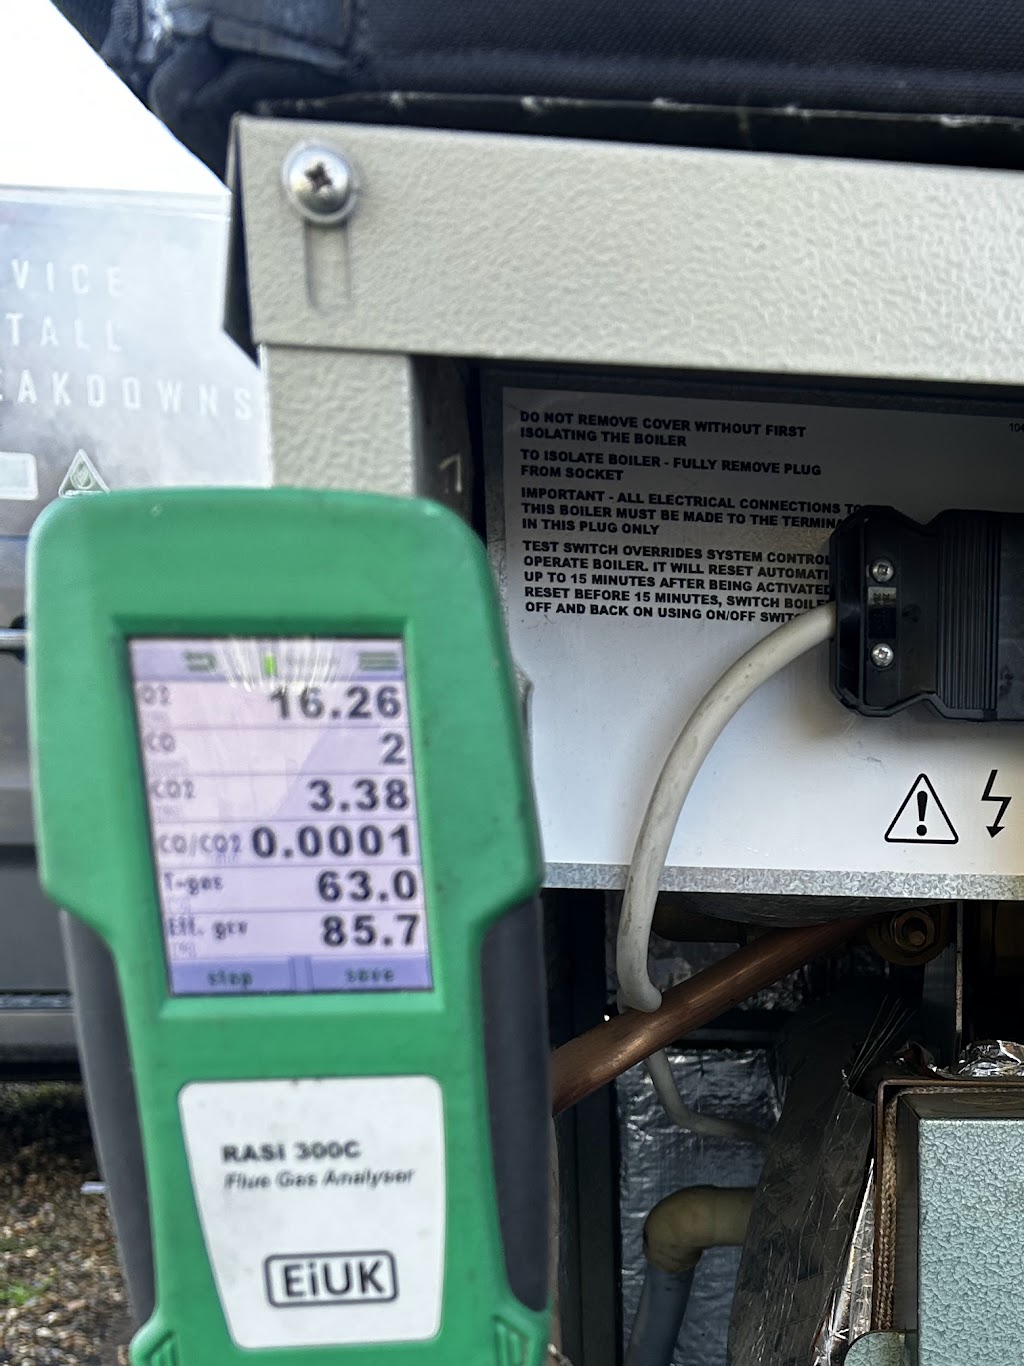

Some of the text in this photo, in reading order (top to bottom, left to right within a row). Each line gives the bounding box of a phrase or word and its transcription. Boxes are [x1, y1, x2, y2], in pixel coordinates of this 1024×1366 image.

[520, 411, 806, 437] DO NOT REMOVE COVER WITHOUT FIRST
[520, 427, 687, 447] ISOLATING THE BOILER
[520, 449, 539, 460] TO
[544, 450, 604, 464] ISOLATE
[608, 454, 661, 467] BOILER
[673, 457, 717, 470] FULLY
[721, 460, 780, 474] REMOVE
[784, 463, 822, 476] PLUG
[520, 465, 624, 480] FROM SOCKET
[521, 487, 605, 501] IMPORTANT
[617, 492, 644, 504] ALL
[648, 493, 735, 508] ELECTRICAL
[740, 498, 841, 514] CONNECTIONS
[521, 503, 555, 515] THIS
[560, 504, 612, 517] BOILER
[616, 507, 656, 520] MUST
[660, 510, 679, 522] BE
[683, 511, 723, 523] MADE
[727, 513, 746, 525] TO
[750, 514, 778, 526] THE
[522, 518, 660, 535] IN THIS PLUG ONLY
[522, 540, 559, 552] TEST
[563, 542, 618, 555] SWITCH
[623, 545, 703, 559] OVERRIDES
[707, 549, 763, 562] SYSTEM
[524, 555, 589, 569] OPERATE
[593, 559, 649, 572] BOILER.
[653, 562, 667, 572] IT
[671, 562, 704, 574] WILL
[708, 564, 753, 577] RESET
[524, 571, 543, 582] UP
[547, 572, 566, 583] TO
[570, 573, 587, 584] 15
[592, 574, 655, 587] MINUTES
[660, 577, 705, 589] AFTER
[709, 580, 752, 592] BEING
[524, 586, 570, 599] RESET
[574, 588, 630, 601] BEFORE
[634, 591, 651, 602] 15
[655, 592, 722, 607] MINUTES,
[726, 595, 780, 609] SWITCH
[525, 601, 552, 613] OFF
[556, 603, 586, 614] AND
[590, 604, 629, 617] BACK
[633, 606, 653, 617] ON
[658, 607, 702, 619] USING
[706, 609, 756, 622] ON/OFF
[269, 686, 402, 720] 16.26
[381, 733, 406, 765] 2
[309, 779, 410, 812] 3.38
[251, 824, 412, 859] 0.0001
[317, 870, 417, 902] 63.0
[322, 914, 419, 947] 85.7
[221, 1143, 286, 1162] RASI
[224, 1168, 416, 1190] Flue Gas Analyser
[283, 1259, 385, 1298] EiUK
